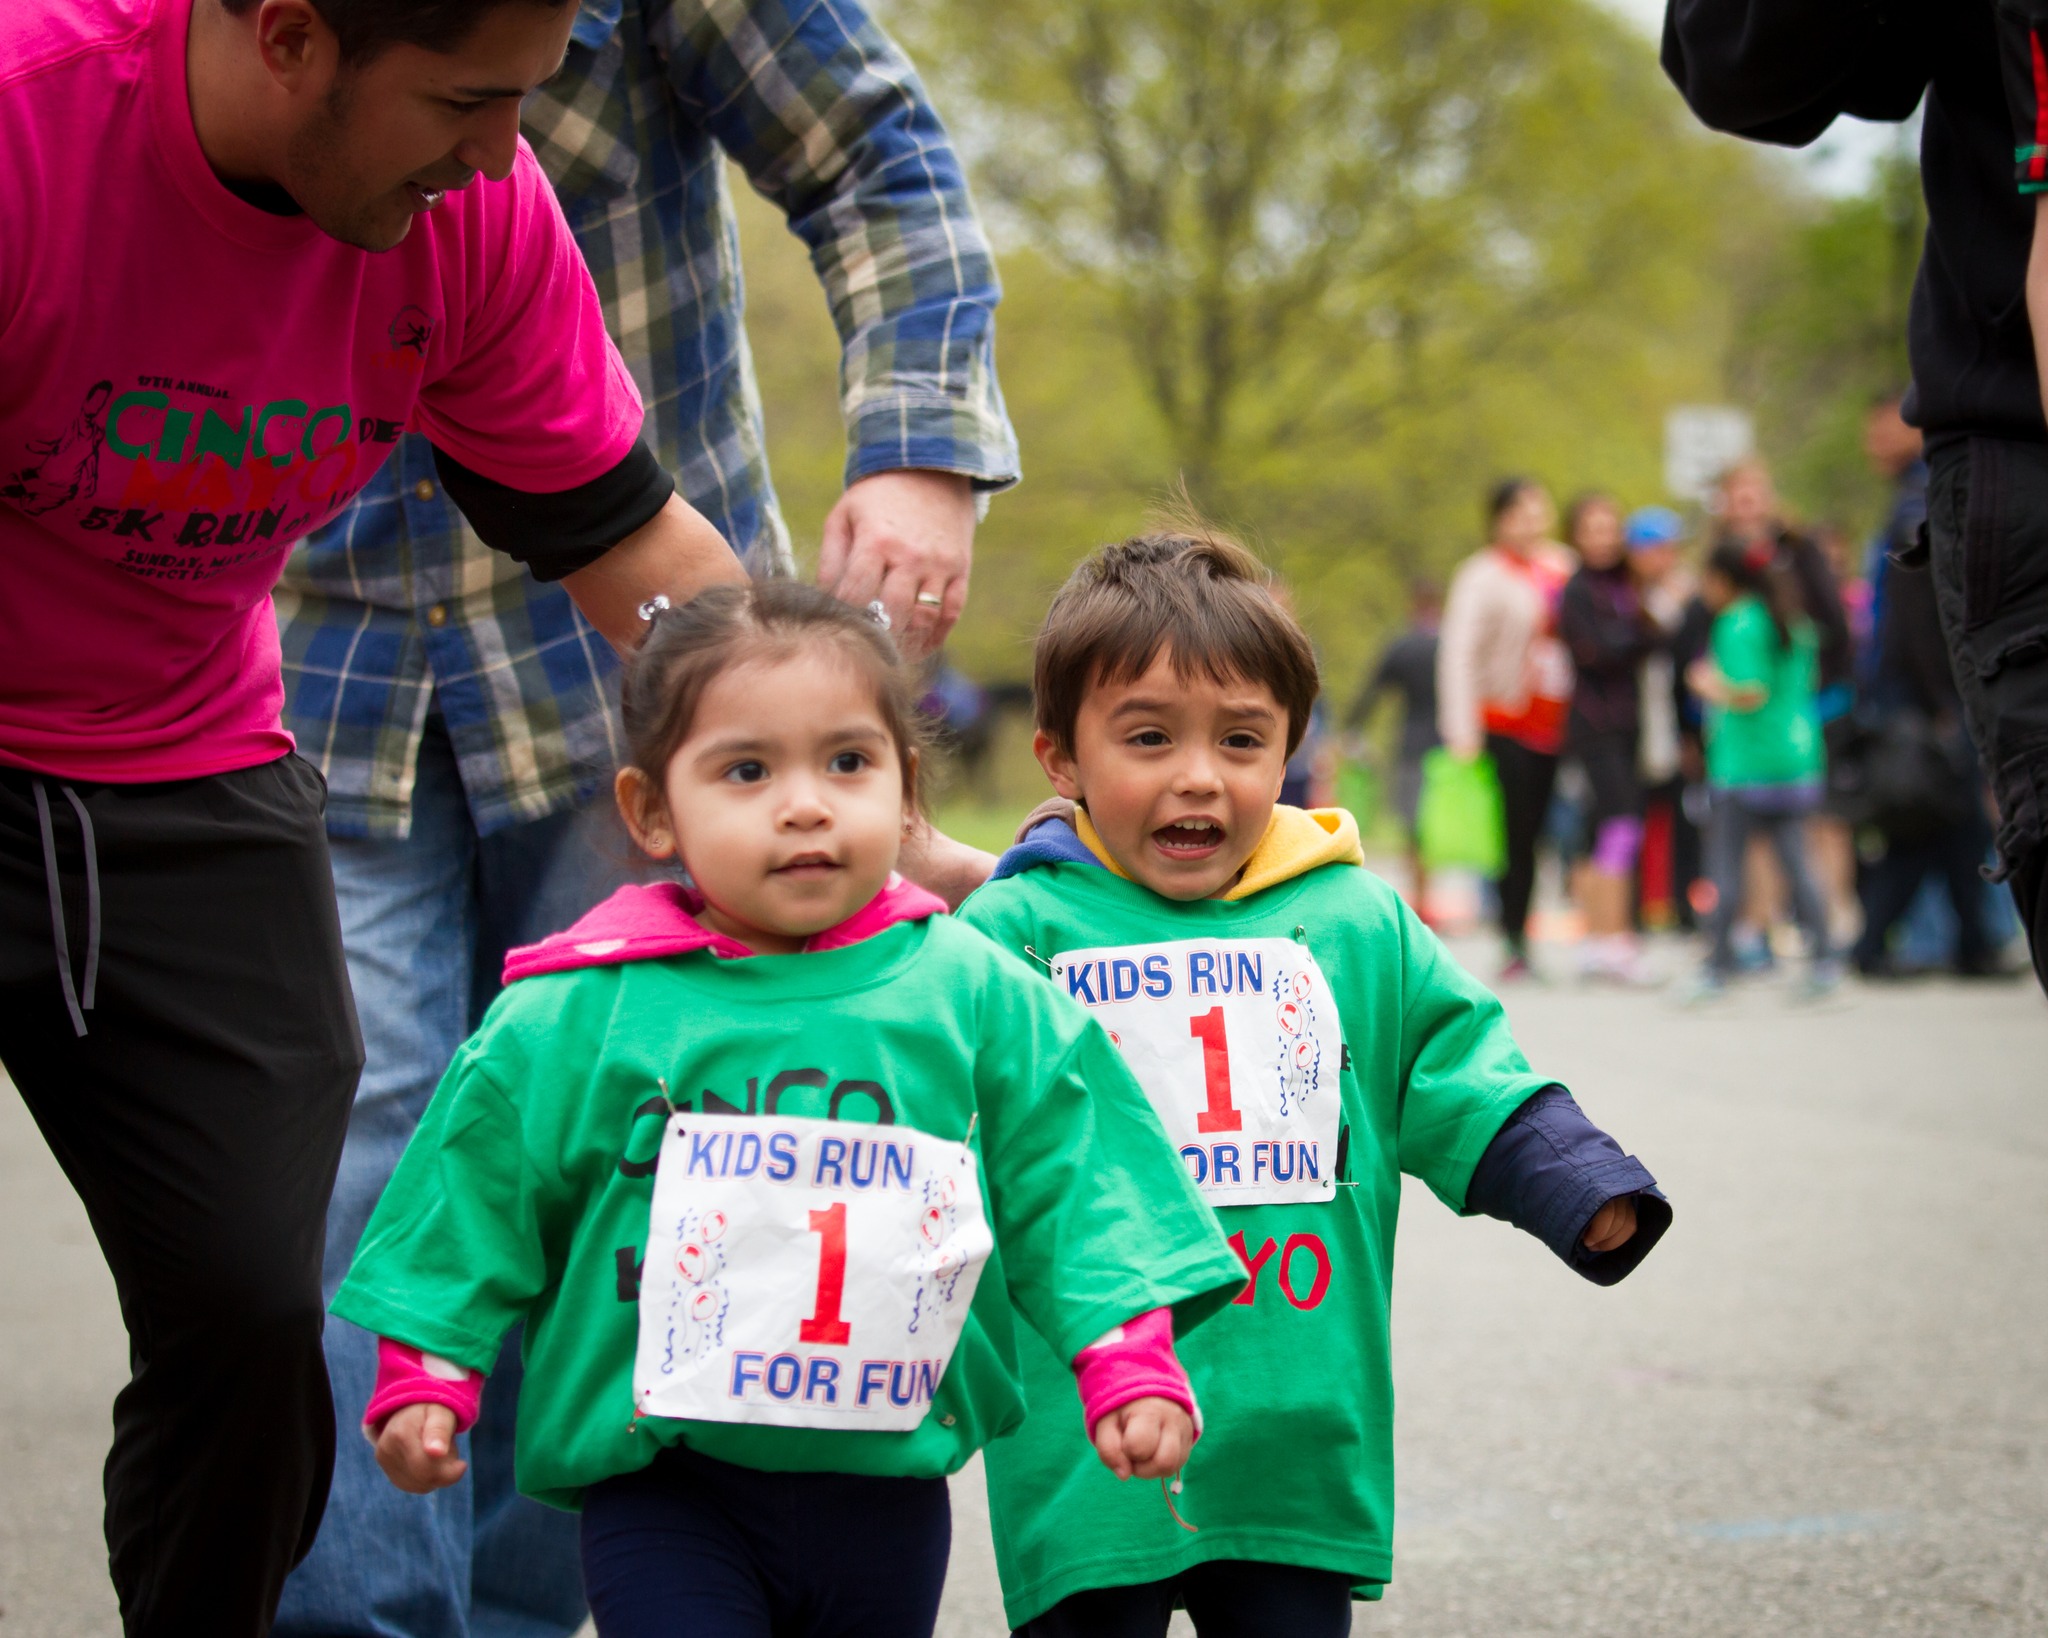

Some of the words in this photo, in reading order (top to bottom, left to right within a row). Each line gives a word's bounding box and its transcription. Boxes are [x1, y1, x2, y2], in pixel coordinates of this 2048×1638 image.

[106, 390, 352, 469] CINCO
[359, 418, 405, 445] DE
[117, 440, 356, 510] MAYO
[80, 505, 164, 542] 5K
[174, 503, 287, 548] RUN
[1065, 953, 1174, 1007] KIDS
[1187, 949, 1265, 997] RUN
[1190, 1006, 1242, 1134] 1
[685, 1131, 799, 1184] KIDS
[811, 1136, 914, 1193] RUN
[1179, 1141, 1242, 1185] OR
[1253, 1141, 1320, 1185] FUN
[799, 1202, 851, 1346] 1
[1227, 1229, 1333, 1311] YO
[729, 1351, 843, 1405] FOR
[855, 1356, 941, 1409] FUN
